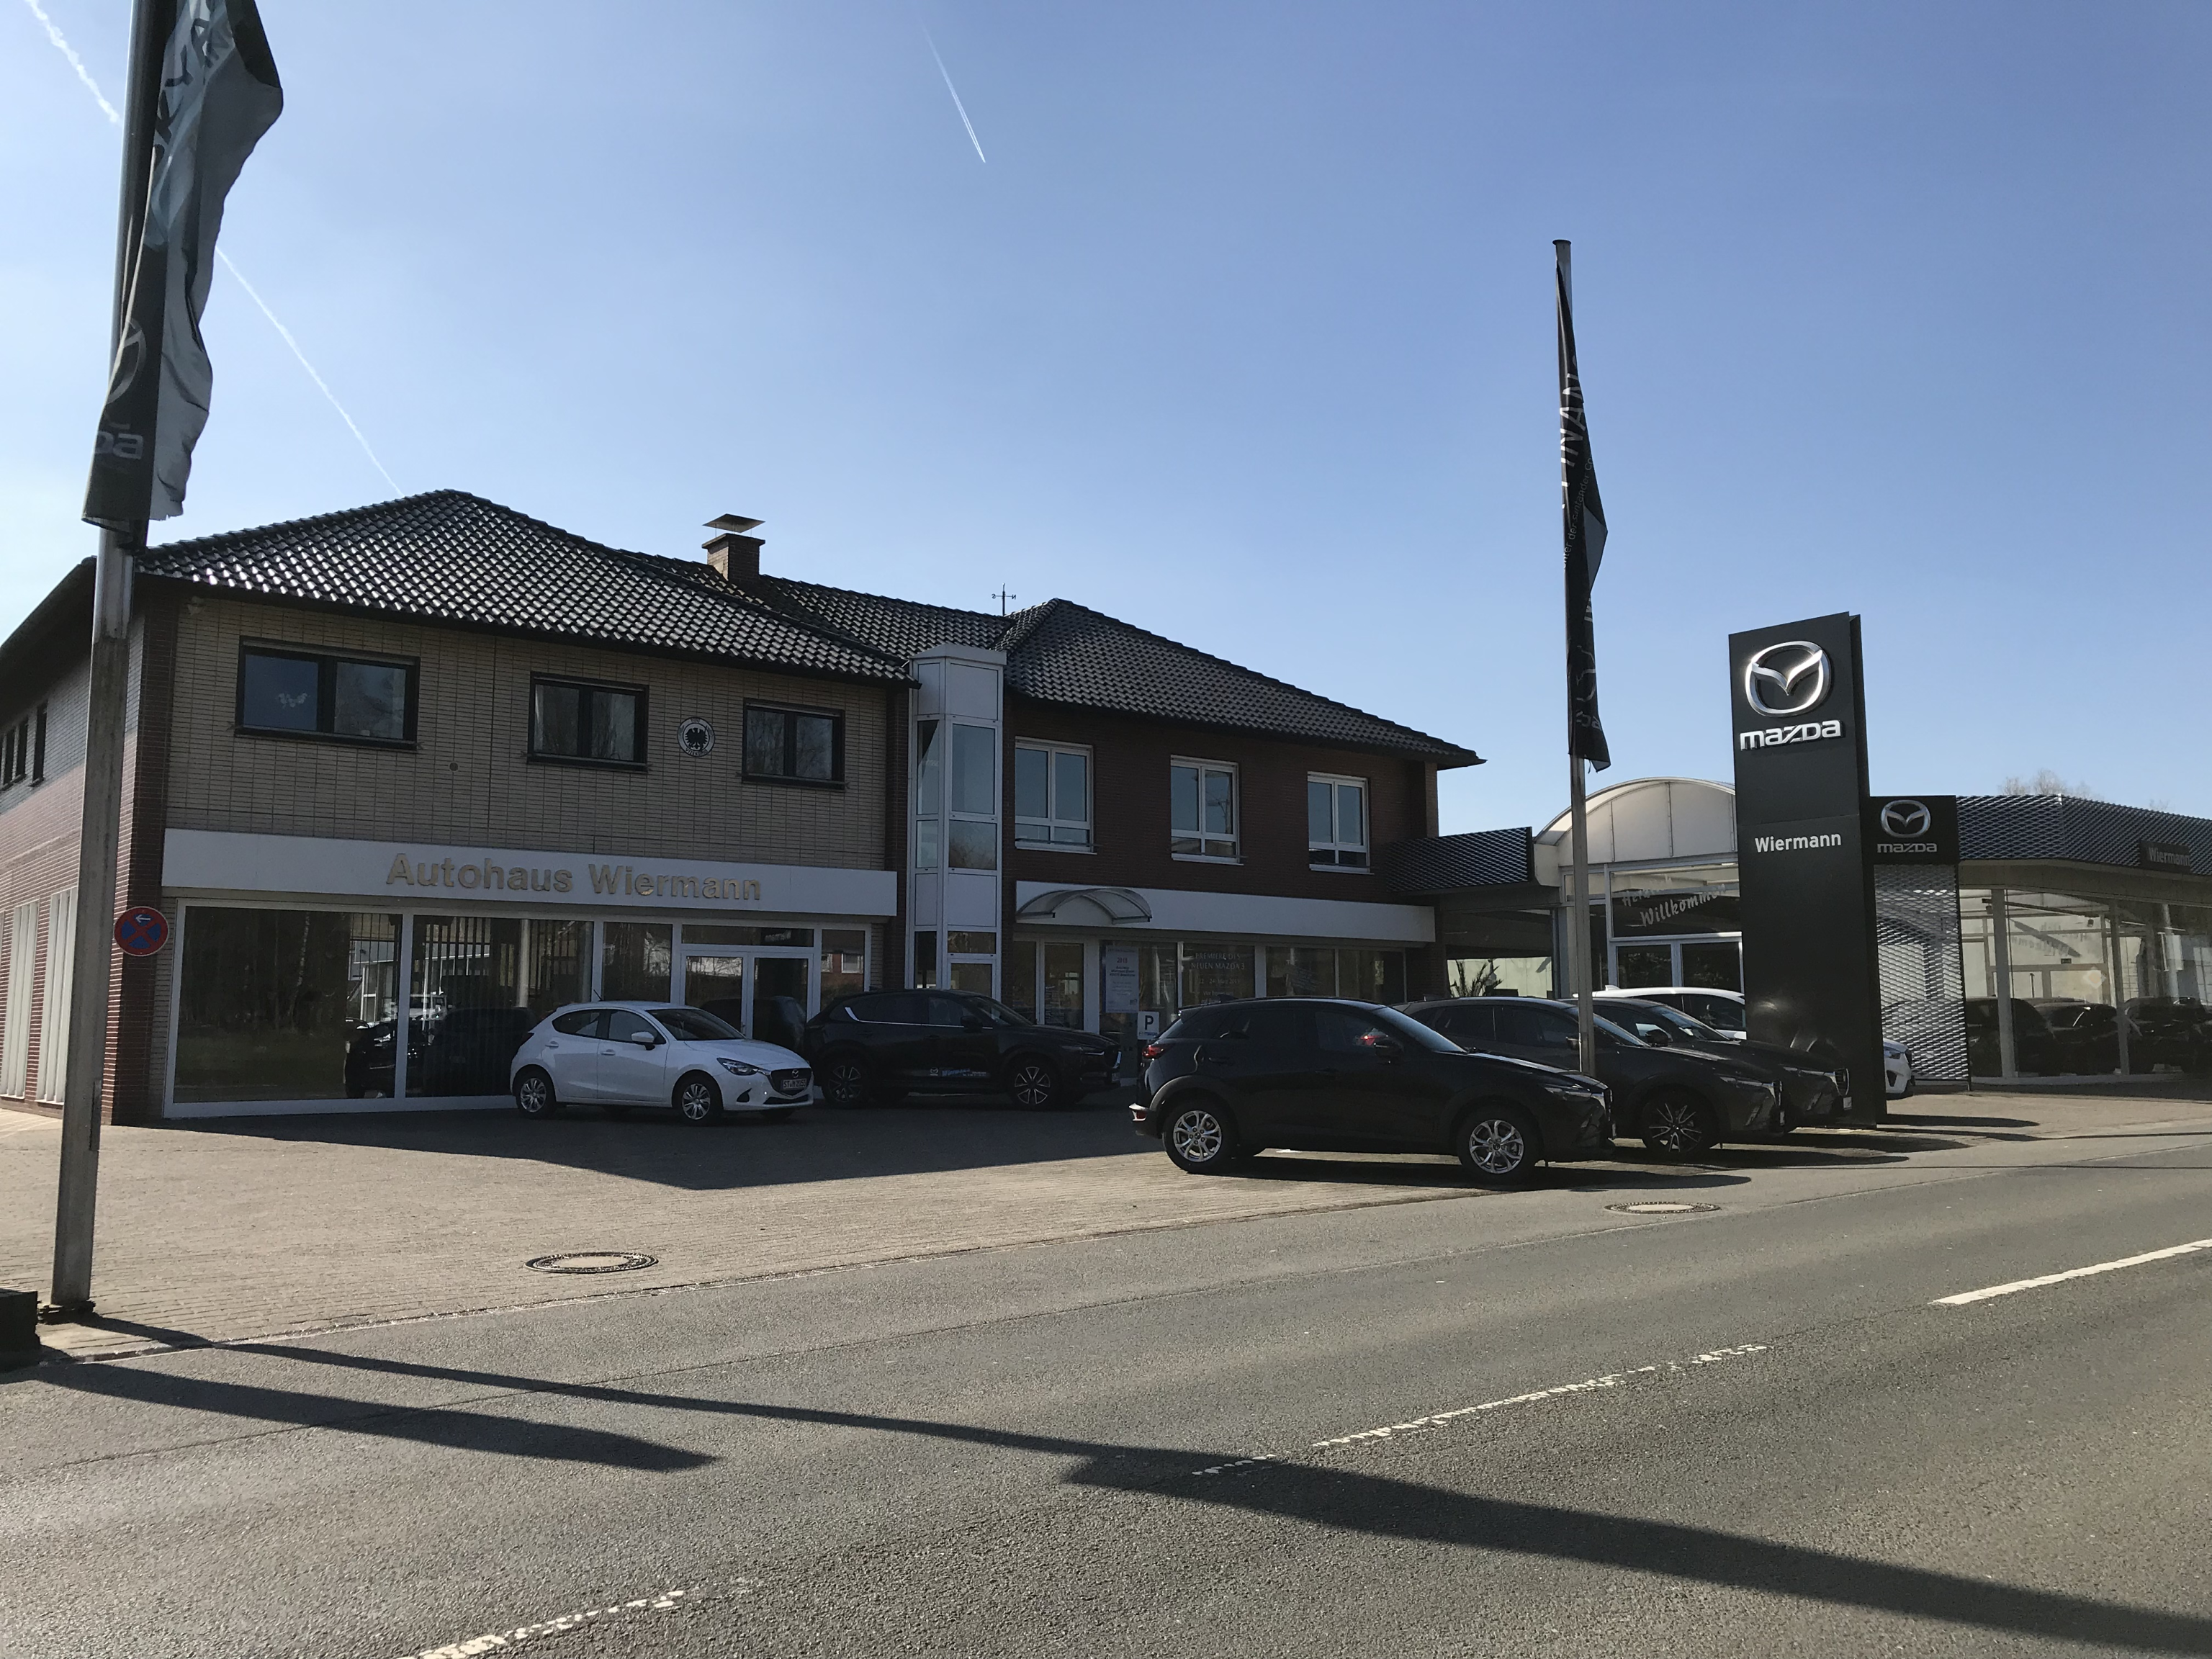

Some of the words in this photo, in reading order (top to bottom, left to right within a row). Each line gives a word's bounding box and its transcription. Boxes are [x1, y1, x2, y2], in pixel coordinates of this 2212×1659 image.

[1739, 719, 1842, 750] mazda
[1755, 832, 1841, 853] Wiermann
[1876, 842, 1938, 853] mazda
[2148, 847, 2191, 866] Wiermann
[386, 853, 574, 893] Autohaus
[588, 863, 761, 900] Wiermann
[1640, 884, 1726, 927] Willkommen
[1145, 1015, 1154, 1030] P
